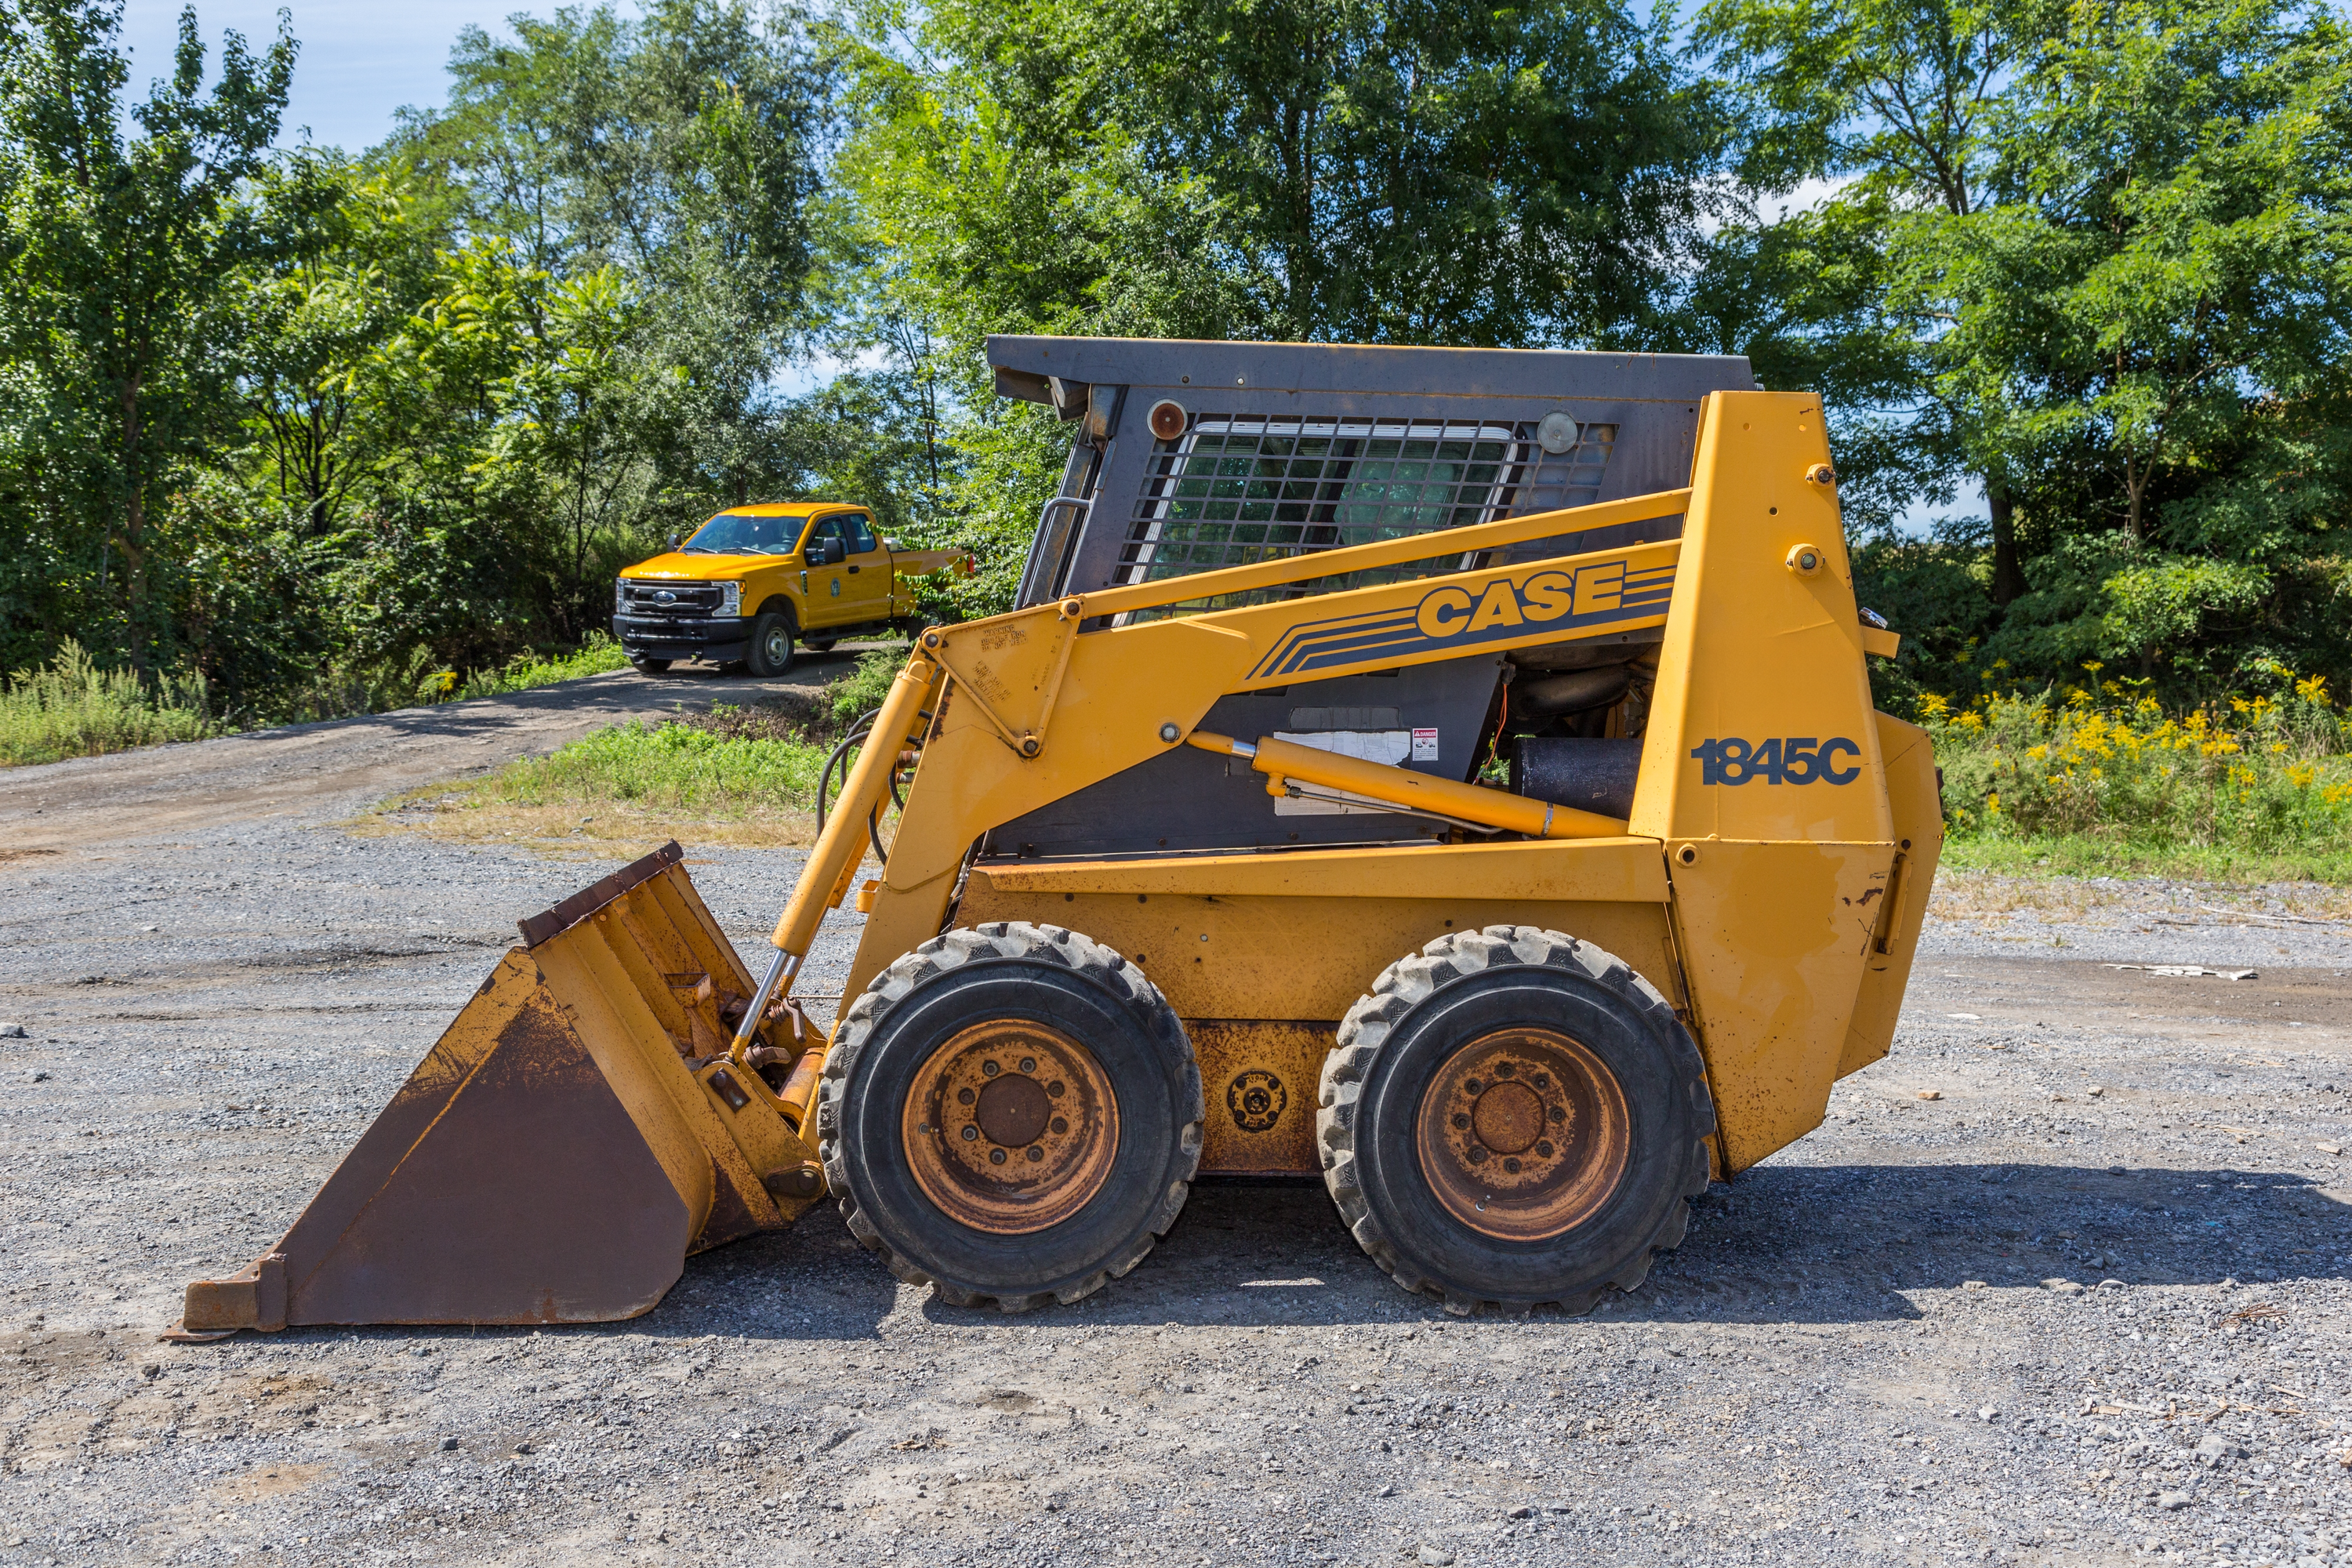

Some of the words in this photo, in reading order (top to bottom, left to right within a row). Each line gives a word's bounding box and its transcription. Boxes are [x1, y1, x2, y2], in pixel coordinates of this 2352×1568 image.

[1417, 562, 1624, 637] CASE
[983, 624, 1014, 636] WARNING
[1011, 630, 1025, 640] IRON
[981, 644, 990, 652] DO
[995, 641, 1006, 649] NOT
[1009, 637, 1027, 647] WELD
[1691, 737, 1861, 786] 1845C
